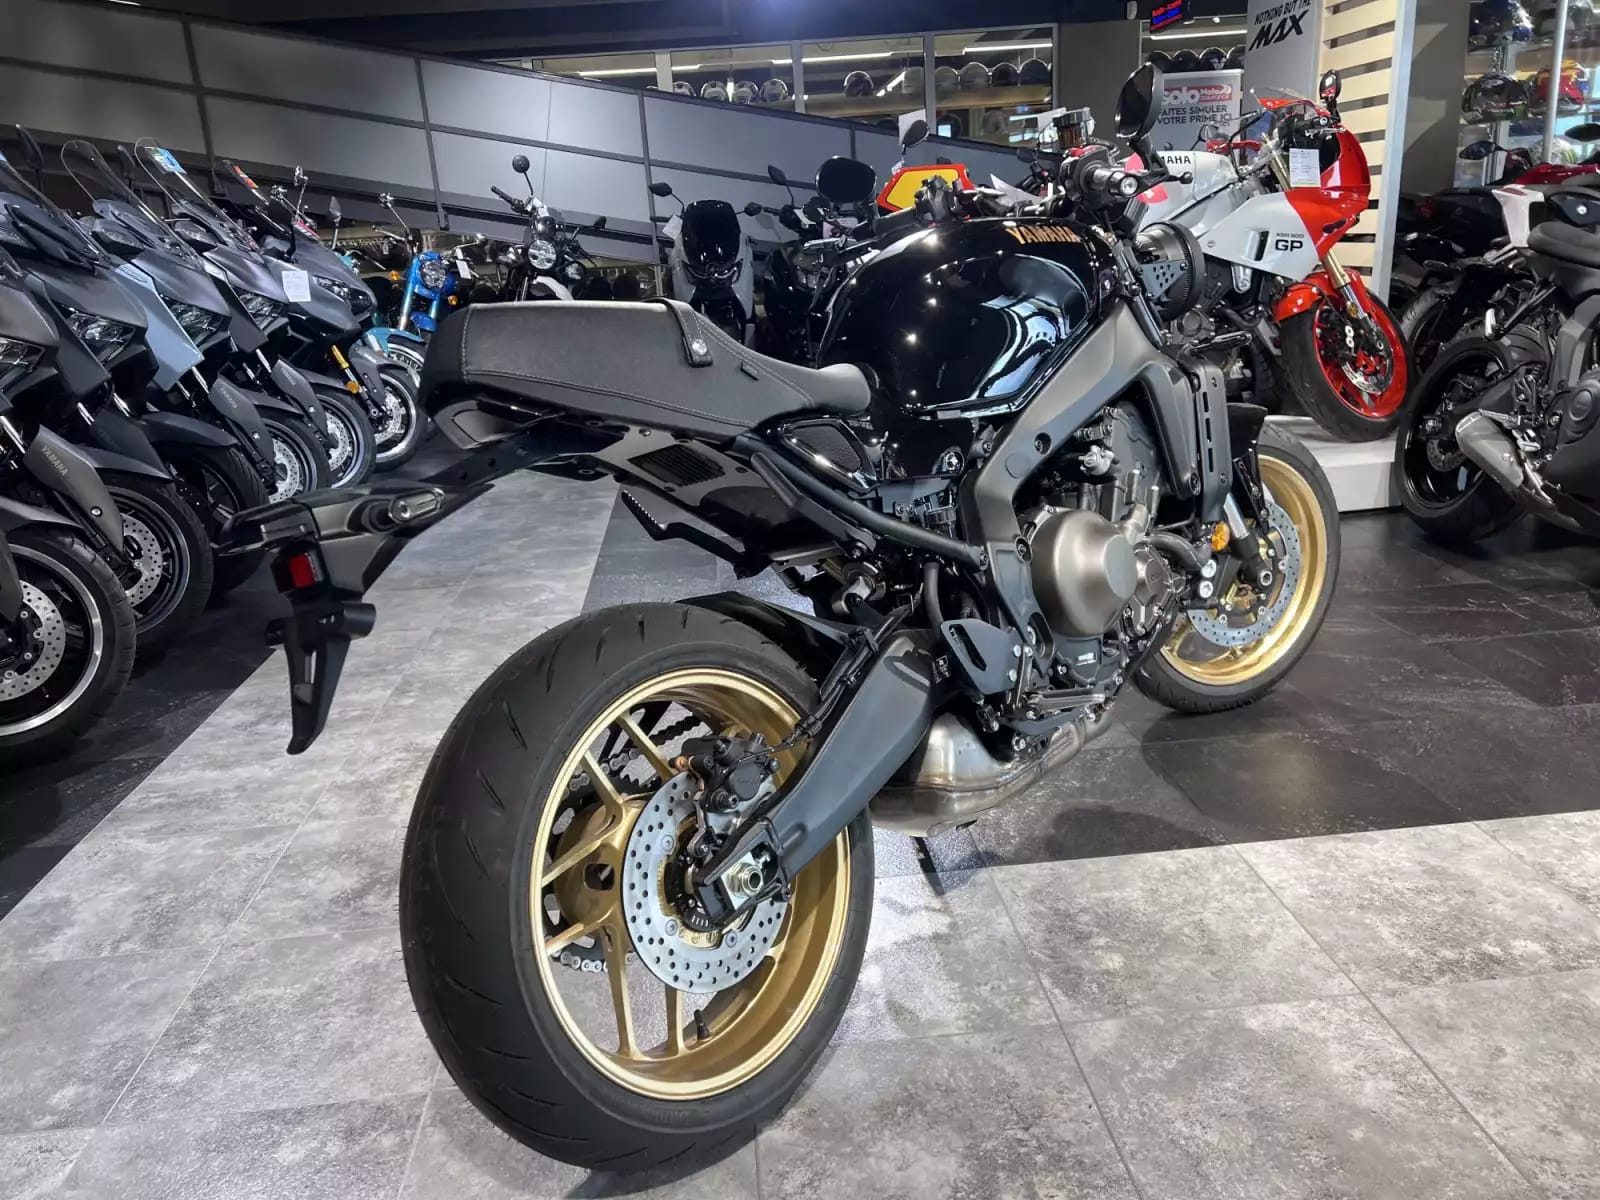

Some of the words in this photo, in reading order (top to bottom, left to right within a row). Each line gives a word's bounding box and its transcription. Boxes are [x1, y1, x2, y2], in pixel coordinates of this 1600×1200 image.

[1248, 9, 1309, 51] MAX
[1190, 105, 1228, 115] SIMULER
[1190, 115, 1217, 123] PRIME
[1005, 225, 1081, 245] YAMAHA
[1275, 239, 1303, 252] GP
[41, 445, 69, 477] YAMAHA
